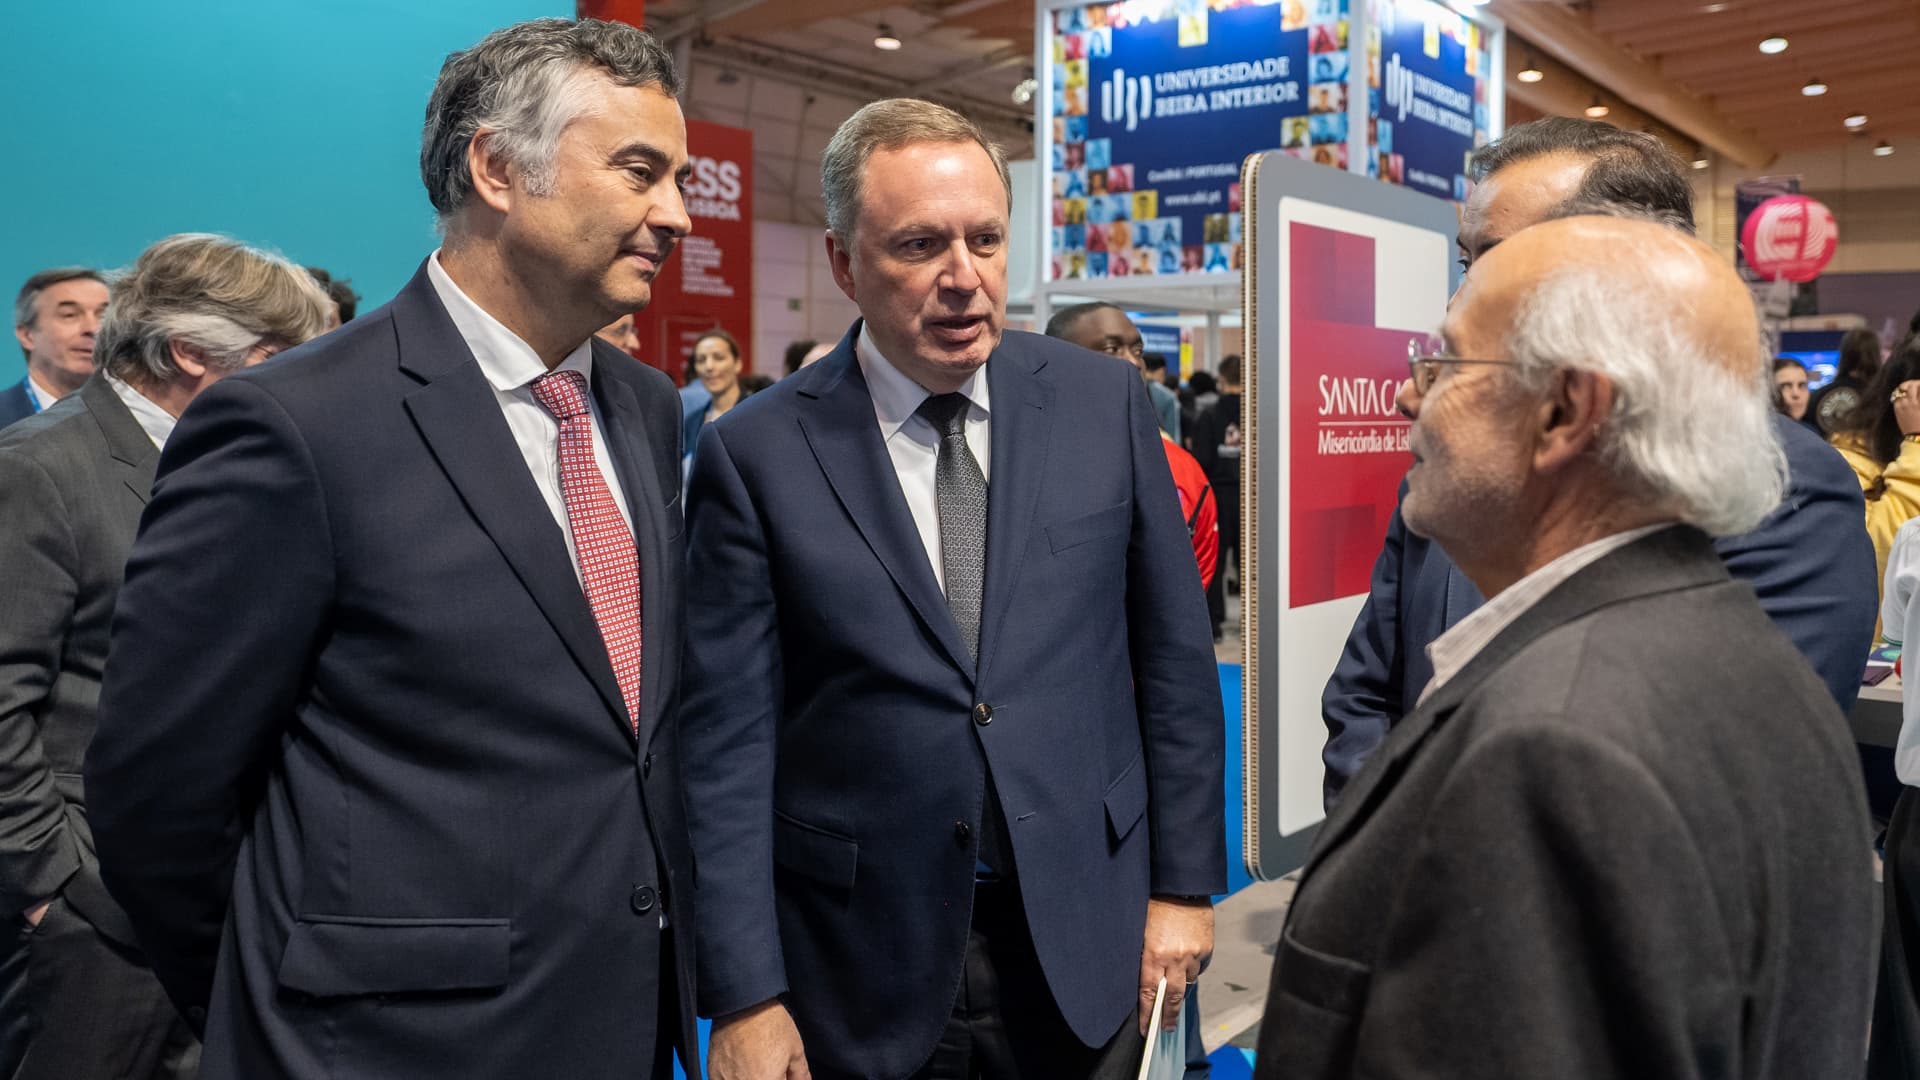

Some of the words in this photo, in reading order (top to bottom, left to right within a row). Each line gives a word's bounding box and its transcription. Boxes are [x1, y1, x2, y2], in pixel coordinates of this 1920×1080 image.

[1154, 56, 1290, 93] UNIVERSIDADE
[1155, 93, 1208, 117] BEIRA
[1210, 81, 1299, 111] INTERIOR
[1318, 374, 1379, 416] SANTA
[1318, 428, 1382, 455] Misericórdia
[1383, 427, 1395, 452] de
